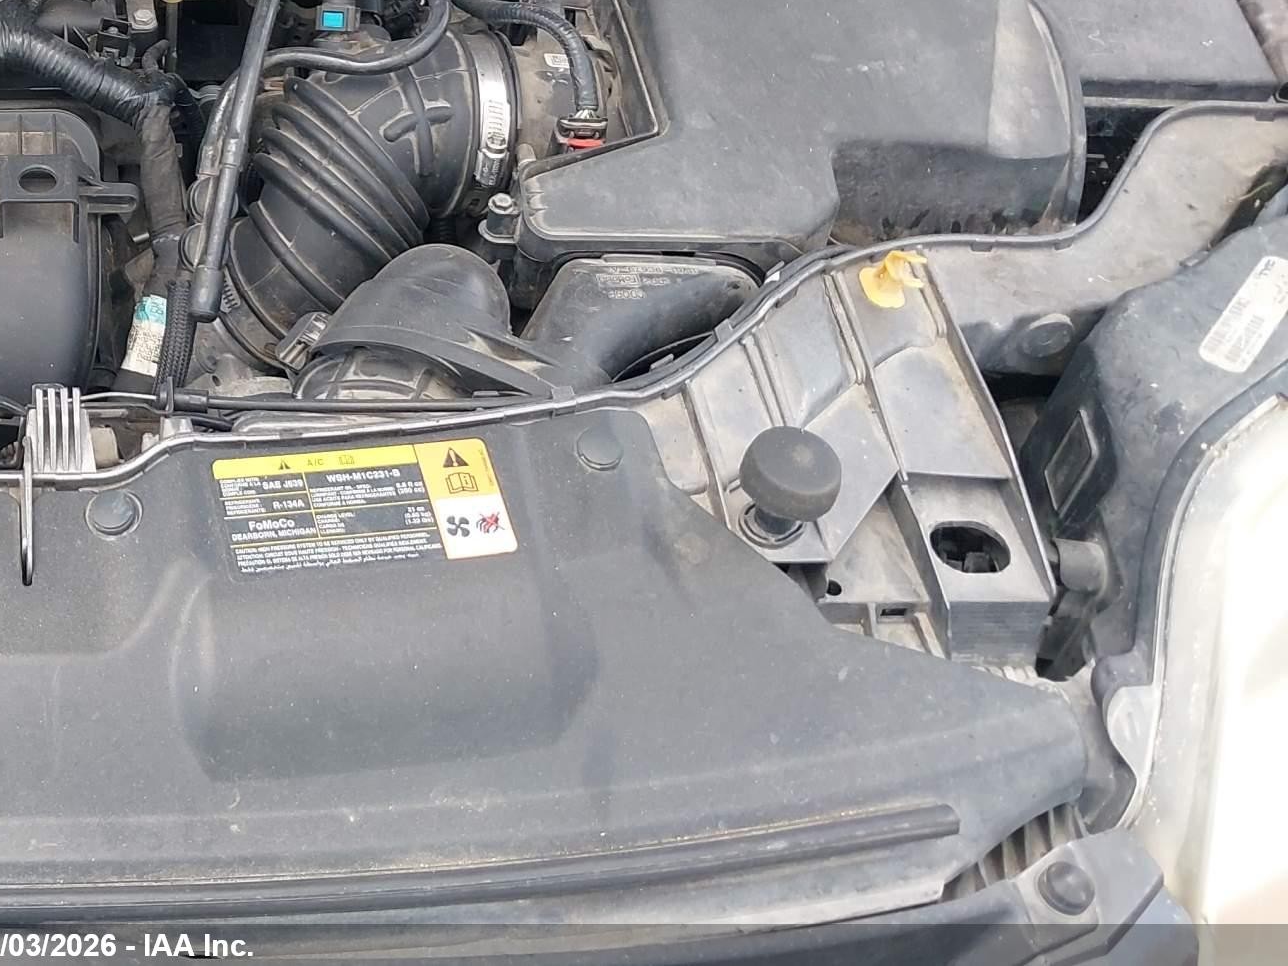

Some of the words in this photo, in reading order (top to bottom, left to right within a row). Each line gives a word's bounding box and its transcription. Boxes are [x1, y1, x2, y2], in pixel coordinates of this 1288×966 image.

[326, 469, 401, 482] WSH-M1C231-B
[263, 481, 282, 490] SAE
[273, 501, 305, 509] R-134A
[248, 520, 295, 531] FoMoCo
[232, 531, 278, 541] DEARBORN,
[278, 528, 316, 538] MICHIGAN
